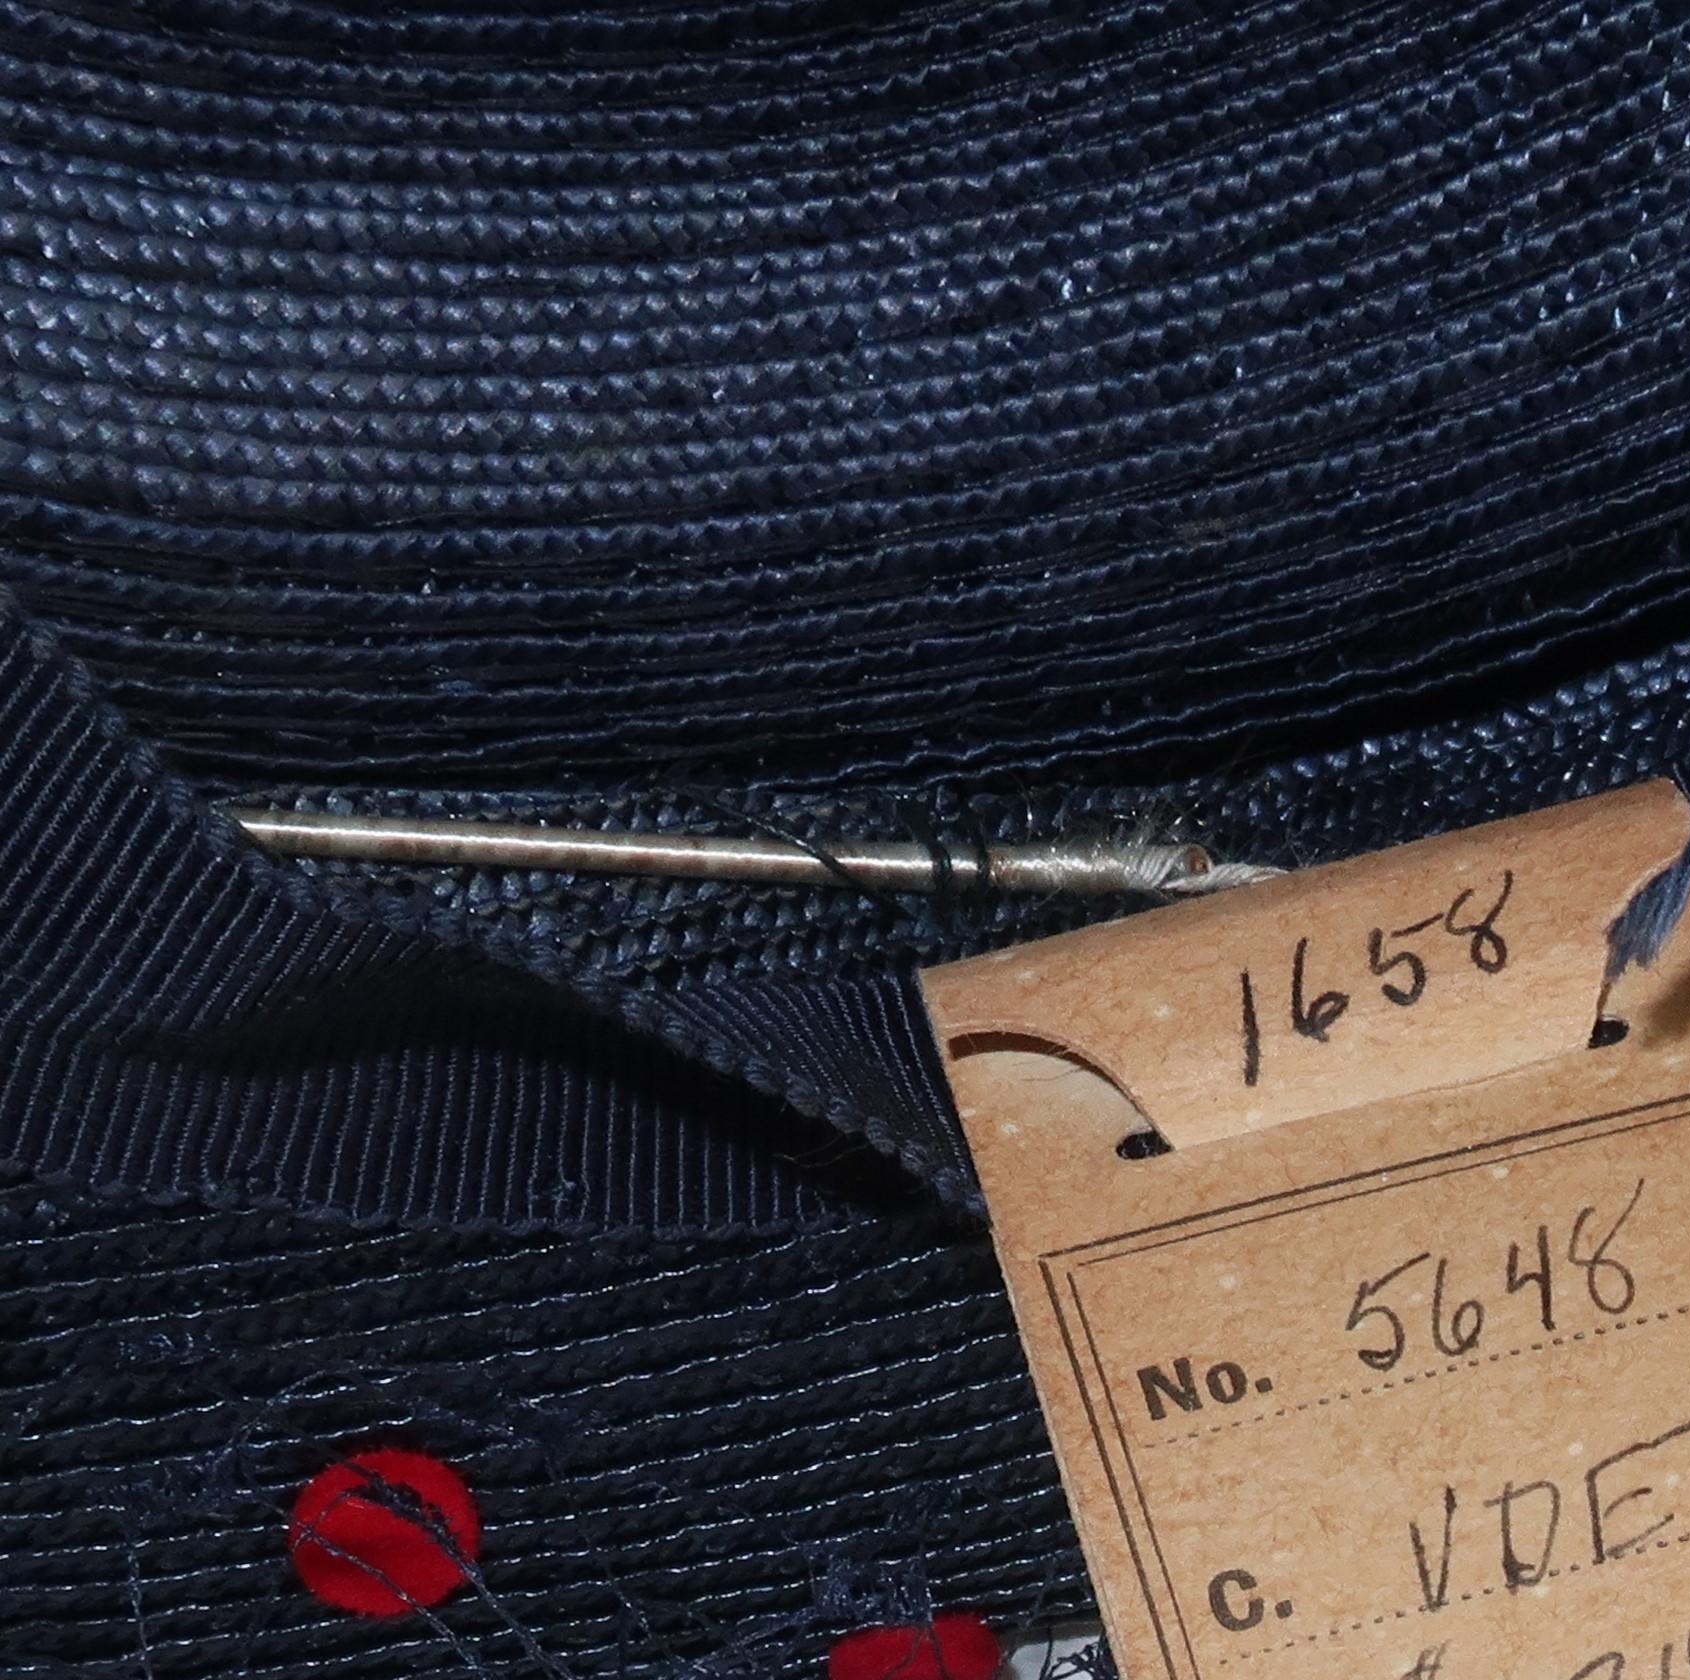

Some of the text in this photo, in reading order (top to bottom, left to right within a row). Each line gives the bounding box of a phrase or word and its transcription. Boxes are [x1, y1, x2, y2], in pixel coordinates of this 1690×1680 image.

[1236, 870, 1515, 1087] 1658
[1137, 1177, 1646, 1421] No. 5648
[1207, 1566, 1293, 1632] C.
